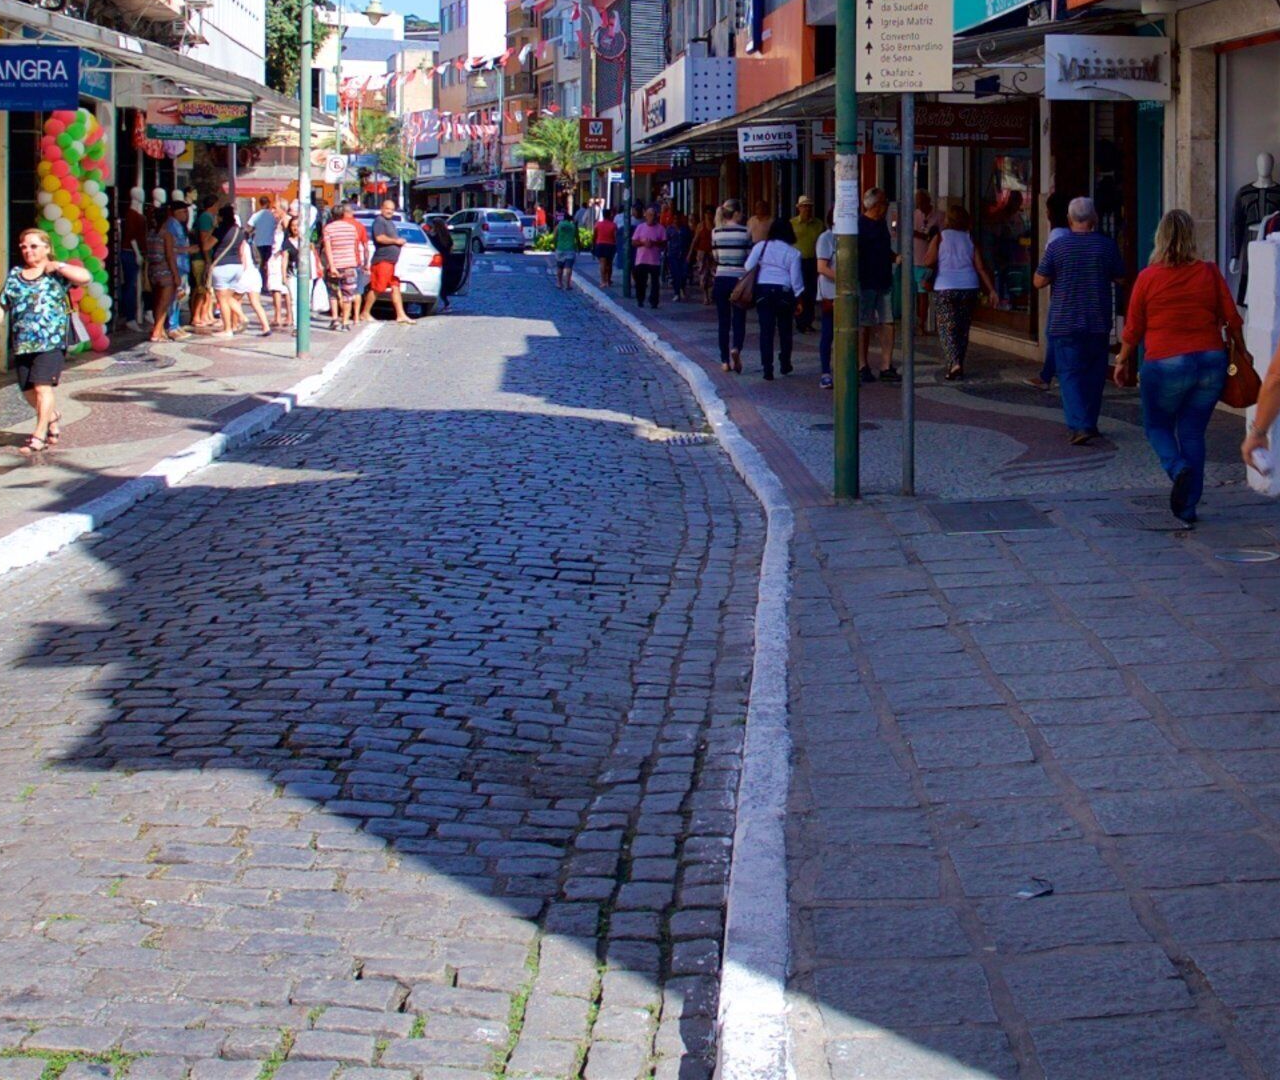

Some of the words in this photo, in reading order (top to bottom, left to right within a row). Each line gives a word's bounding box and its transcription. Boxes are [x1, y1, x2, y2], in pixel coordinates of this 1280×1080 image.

[881, 3, 891, 12] da
[894, 2, 929, 12] Saudade
[881, 18, 904, 29] Igreja
[907, 17, 933, 26] Matriz
[880, 32, 920, 41] Convento
[880, 43, 895, 52] São
[897, 42, 944, 51] Bernardino
[880, 54, 891, 63] de
[893, 54, 913, 63] Sena
[880, 68, 915, 77] Chafariz
[880, 80, 890, 88] da
[892, 79, 924, 88] Carioca
[752, 131, 793, 141] IMÓVEIS
